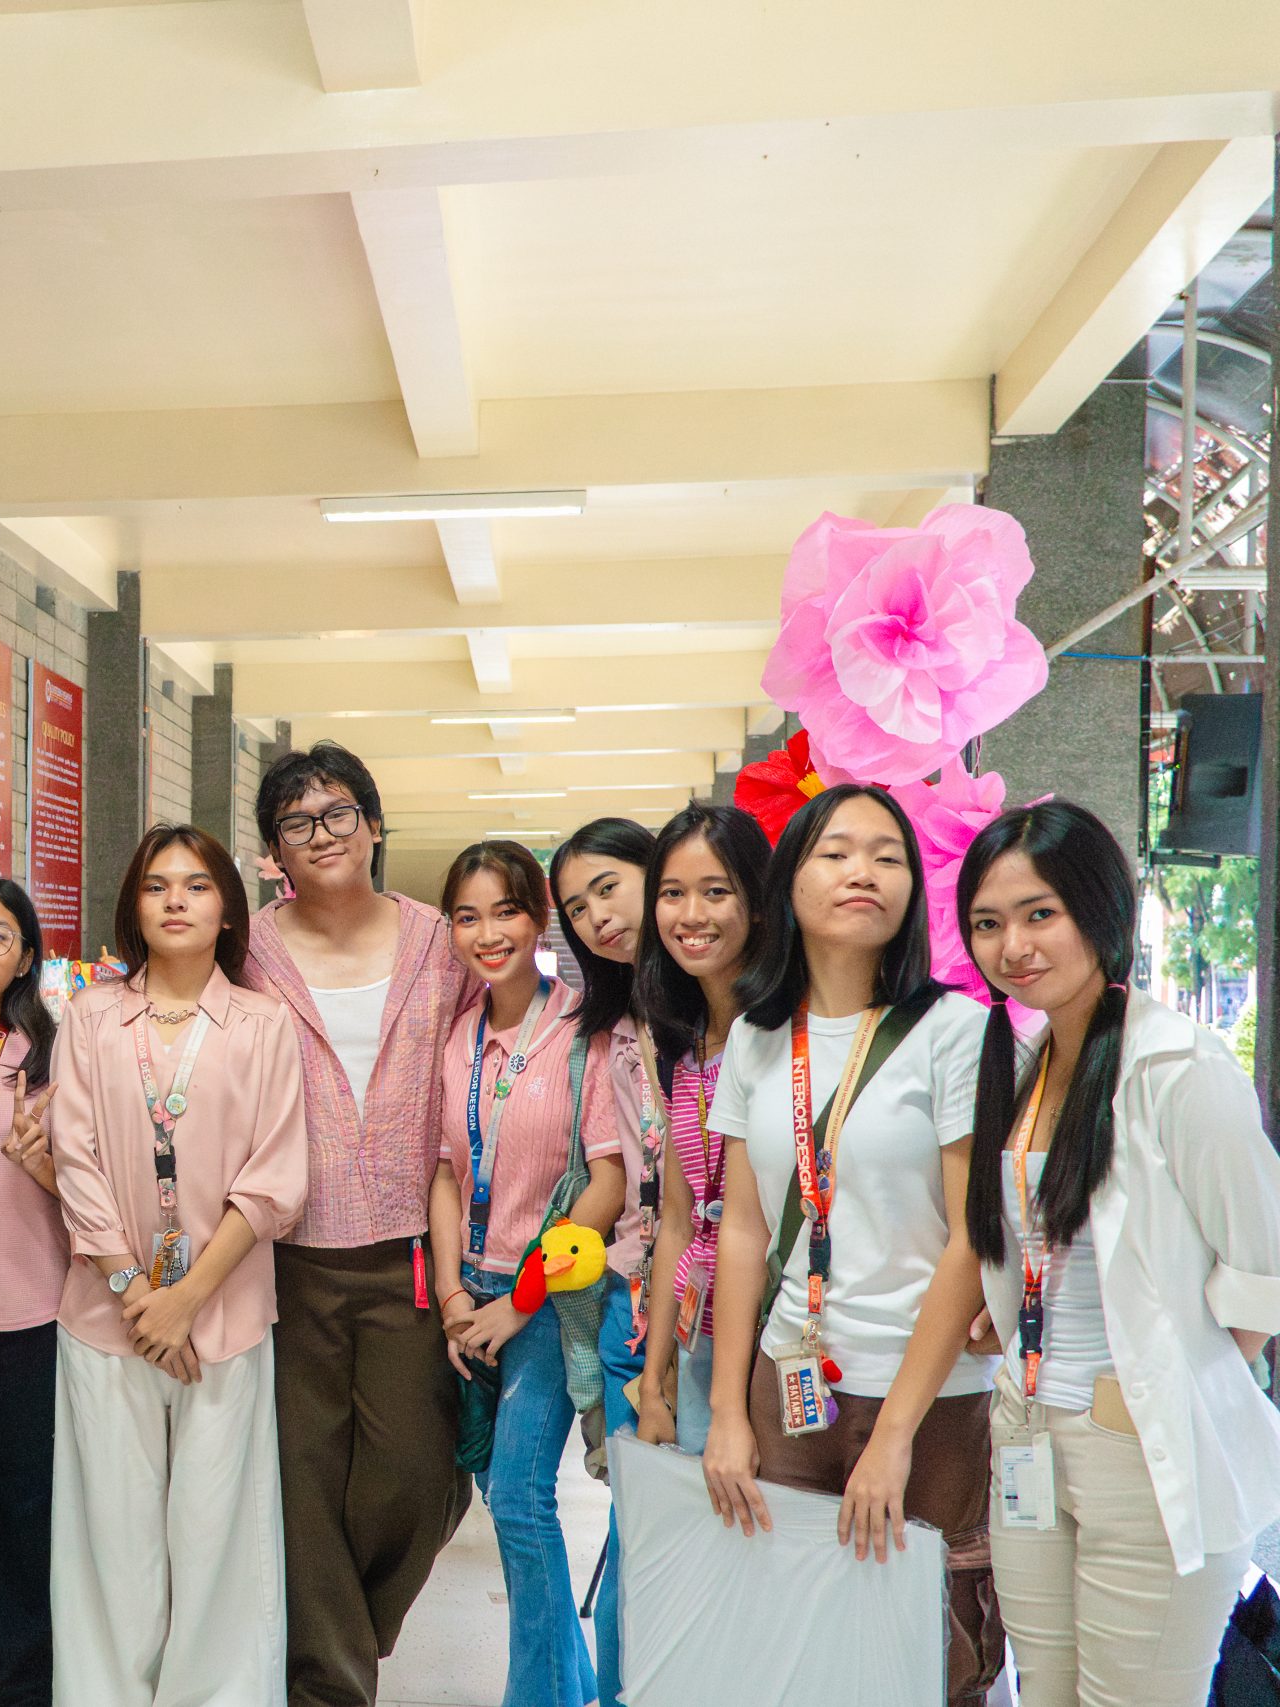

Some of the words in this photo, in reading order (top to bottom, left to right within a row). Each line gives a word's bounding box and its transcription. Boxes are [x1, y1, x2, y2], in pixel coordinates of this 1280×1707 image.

[140, 1061, 155, 1099] DESIGN
[470, 1043, 483, 1090] INTERIOR
[468, 1092, 478, 1131] DESIGN
[641, 1083, 652, 1121] DESIGN
[793, 1056, 808, 1131] INTERIOR
[795, 1132, 815, 1196] DESIGN
[801, 1375, 812, 1402] PARA
[805, 1404, 816, 1418] SA
